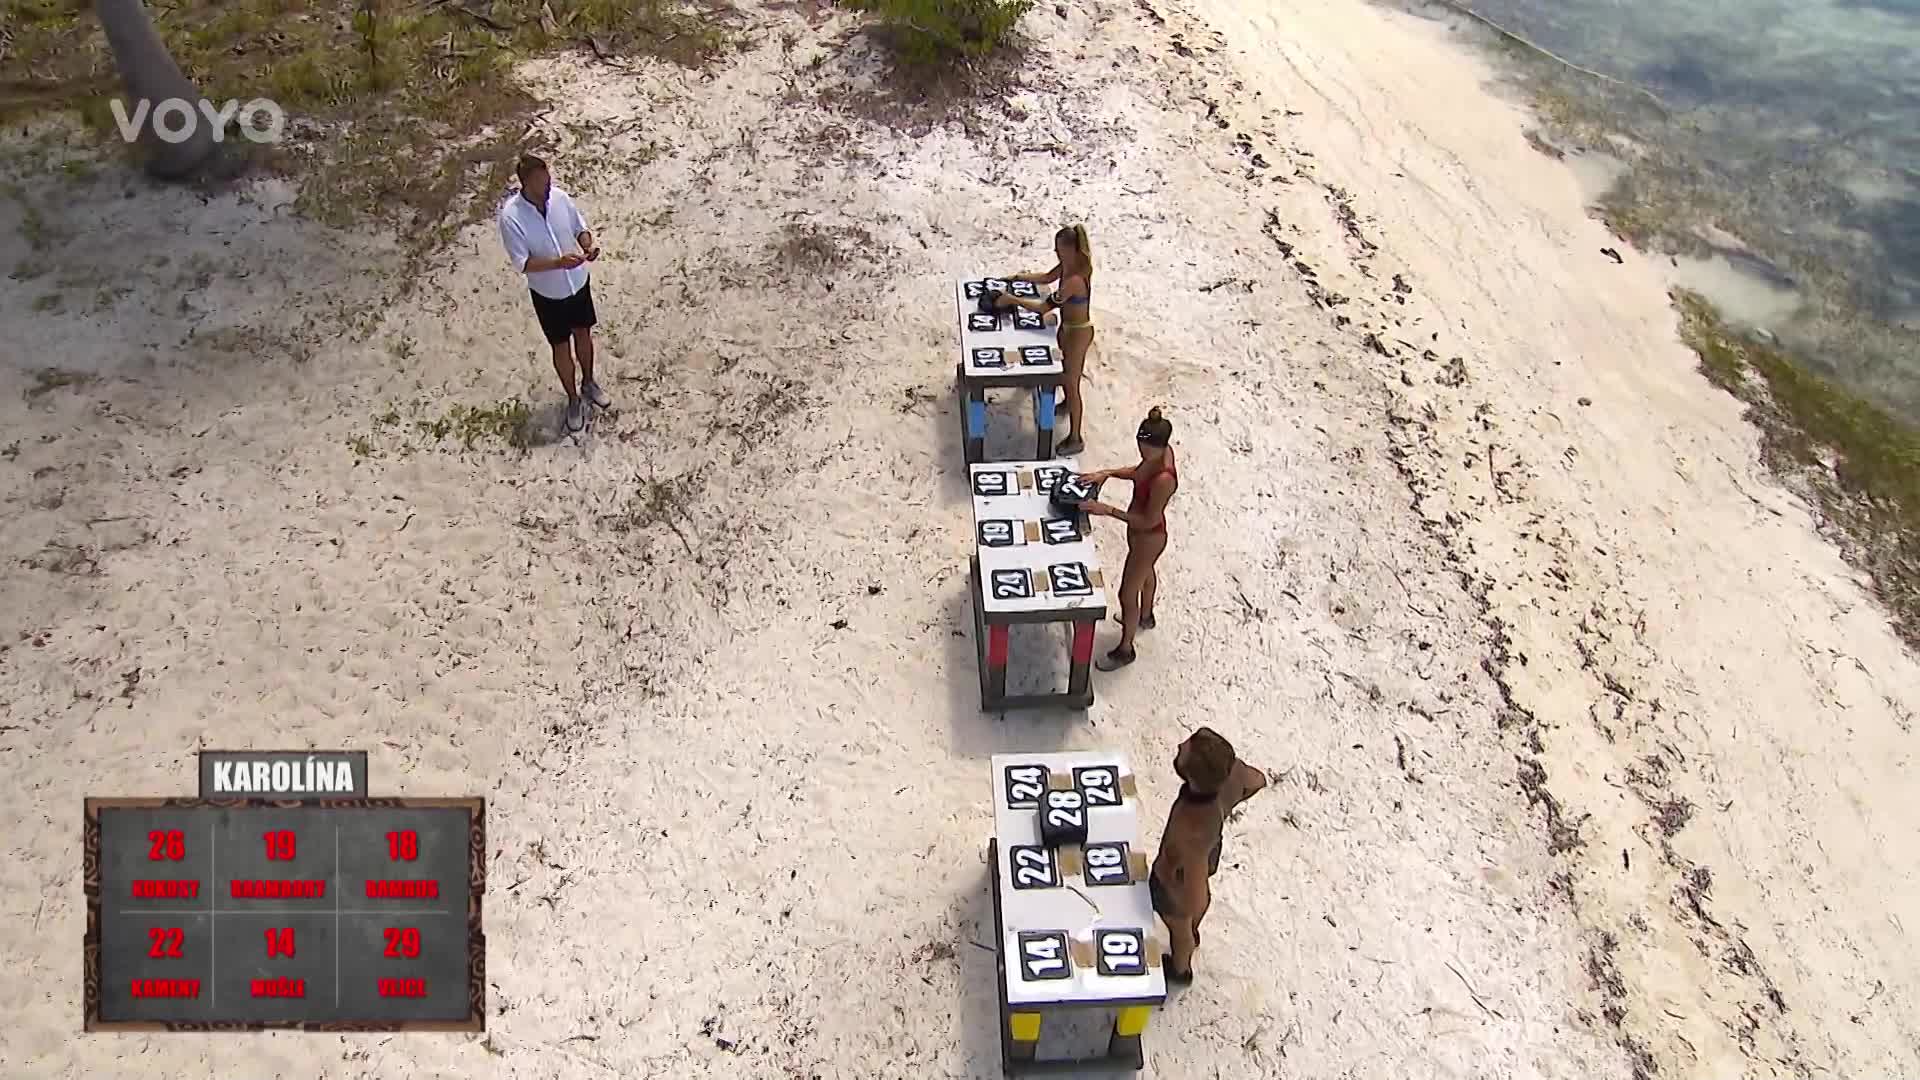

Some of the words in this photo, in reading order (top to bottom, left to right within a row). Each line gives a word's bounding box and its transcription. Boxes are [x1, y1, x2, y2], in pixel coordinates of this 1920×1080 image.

[972, 315, 995, 327] 14
[977, 349, 1001, 365] 19
[1025, 348, 1049, 362] 18
[977, 473, 1003, 493] 18
[982, 523, 1009, 543] 19
[1047, 520, 1077, 541] 14
[997, 572, 1026, 597] 24
[1053, 565, 1085, 588] 22
[1011, 767, 1044, 800] 24
[1081, 769, 1116, 805] 29
[1048, 791, 1083, 827] 28
[1016, 848, 1051, 885] 22
[1088, 847, 1124, 882] 18
[1025, 937, 1063, 976] 14
[1103, 934, 1141, 971] 19
